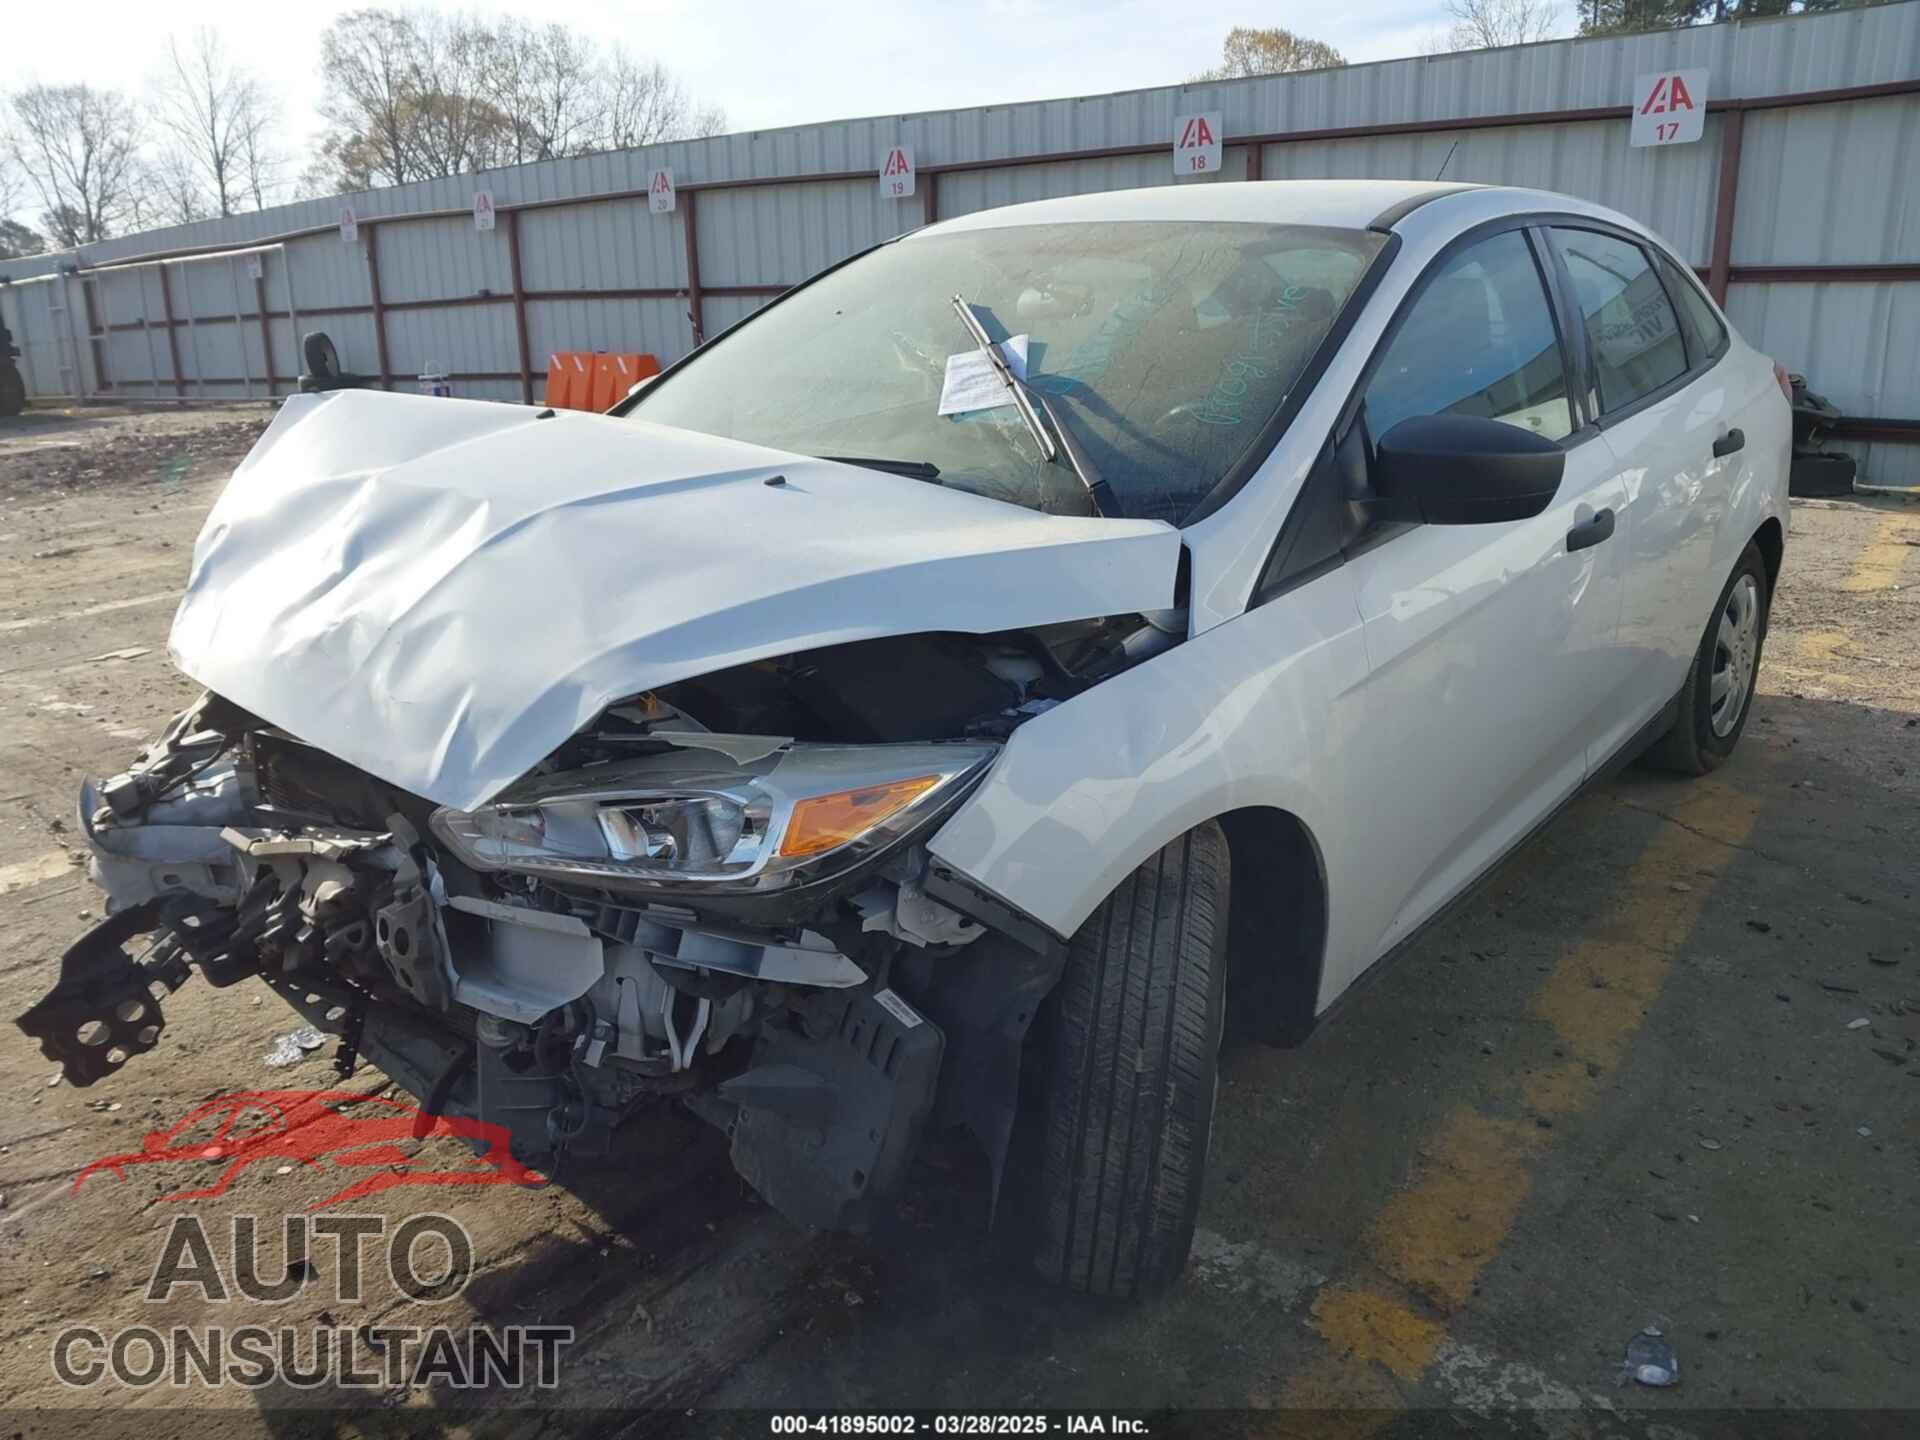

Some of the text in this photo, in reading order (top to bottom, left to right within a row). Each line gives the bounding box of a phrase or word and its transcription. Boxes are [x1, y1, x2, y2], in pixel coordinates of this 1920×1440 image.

[1656, 122, 1679, 141] 17
[1191, 155, 1206, 171] 18
[891, 182, 904, 194] 19
[657, 199, 668, 210] 20
